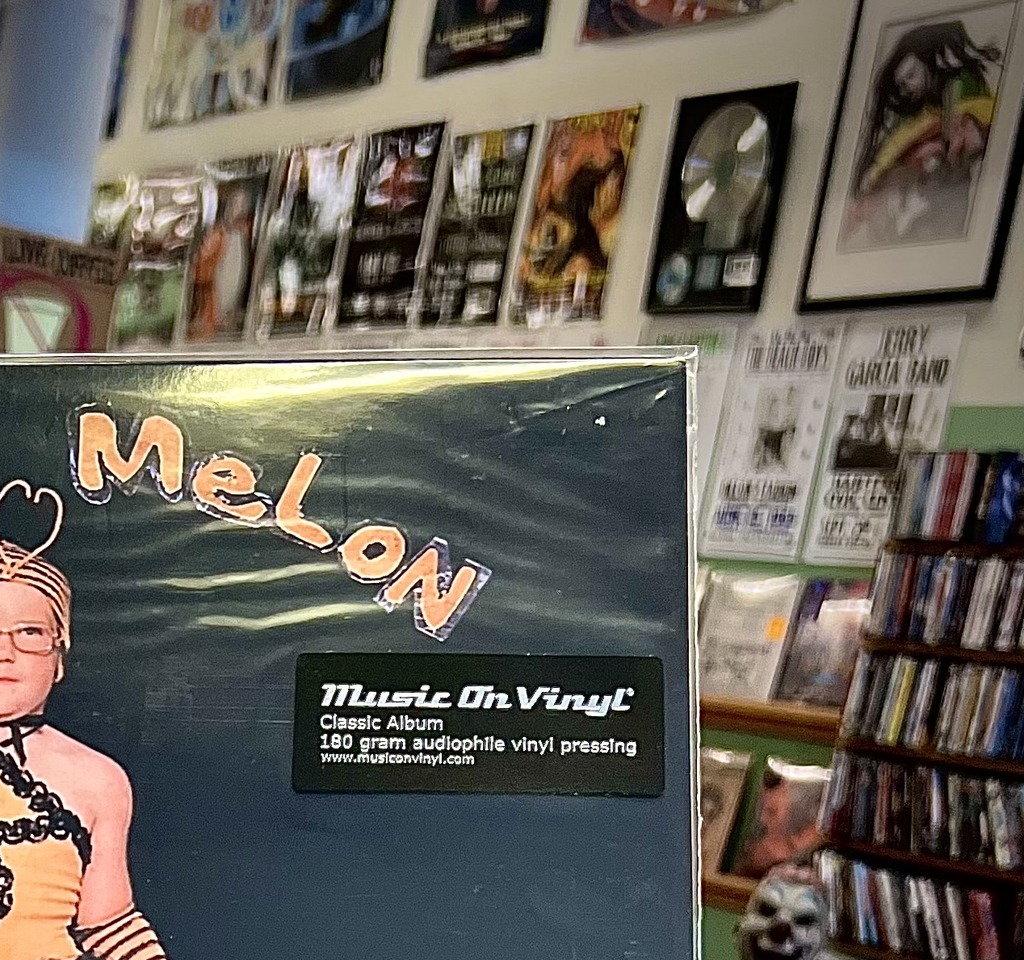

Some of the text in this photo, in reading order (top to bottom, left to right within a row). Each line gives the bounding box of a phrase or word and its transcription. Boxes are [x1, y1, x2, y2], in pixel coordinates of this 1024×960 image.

[321, 684, 452, 709] Music
[457, 686, 513, 710] On
[320, 714, 443, 731] Classic Album
[320, 734, 637, 756] 180 gram audiophile vinyl pressing
[320, 752, 475, 766] www.musiconvinyl.com
